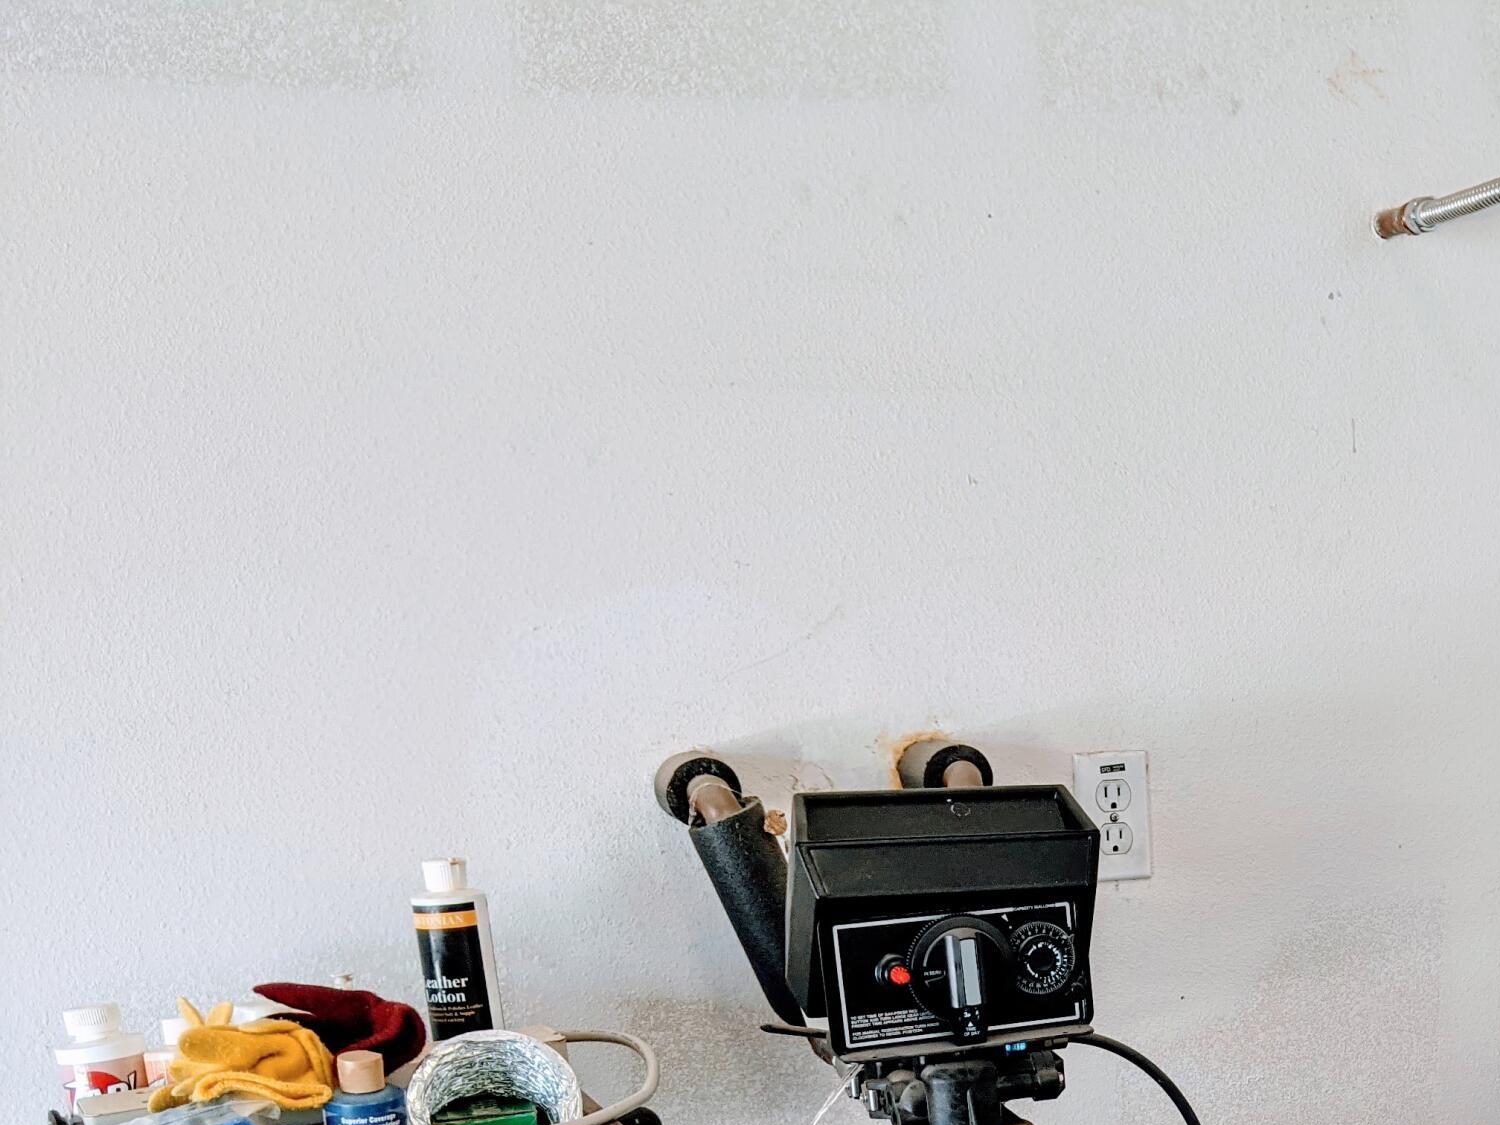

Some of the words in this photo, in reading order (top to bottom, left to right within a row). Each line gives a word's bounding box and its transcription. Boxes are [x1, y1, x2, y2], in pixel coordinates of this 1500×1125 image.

[425, 976, 469, 989] eather
[425, 989, 467, 1004] Lotion
[340, 1117, 368, 1125] Superior
[368, 1113, 397, 1123] Coverage
